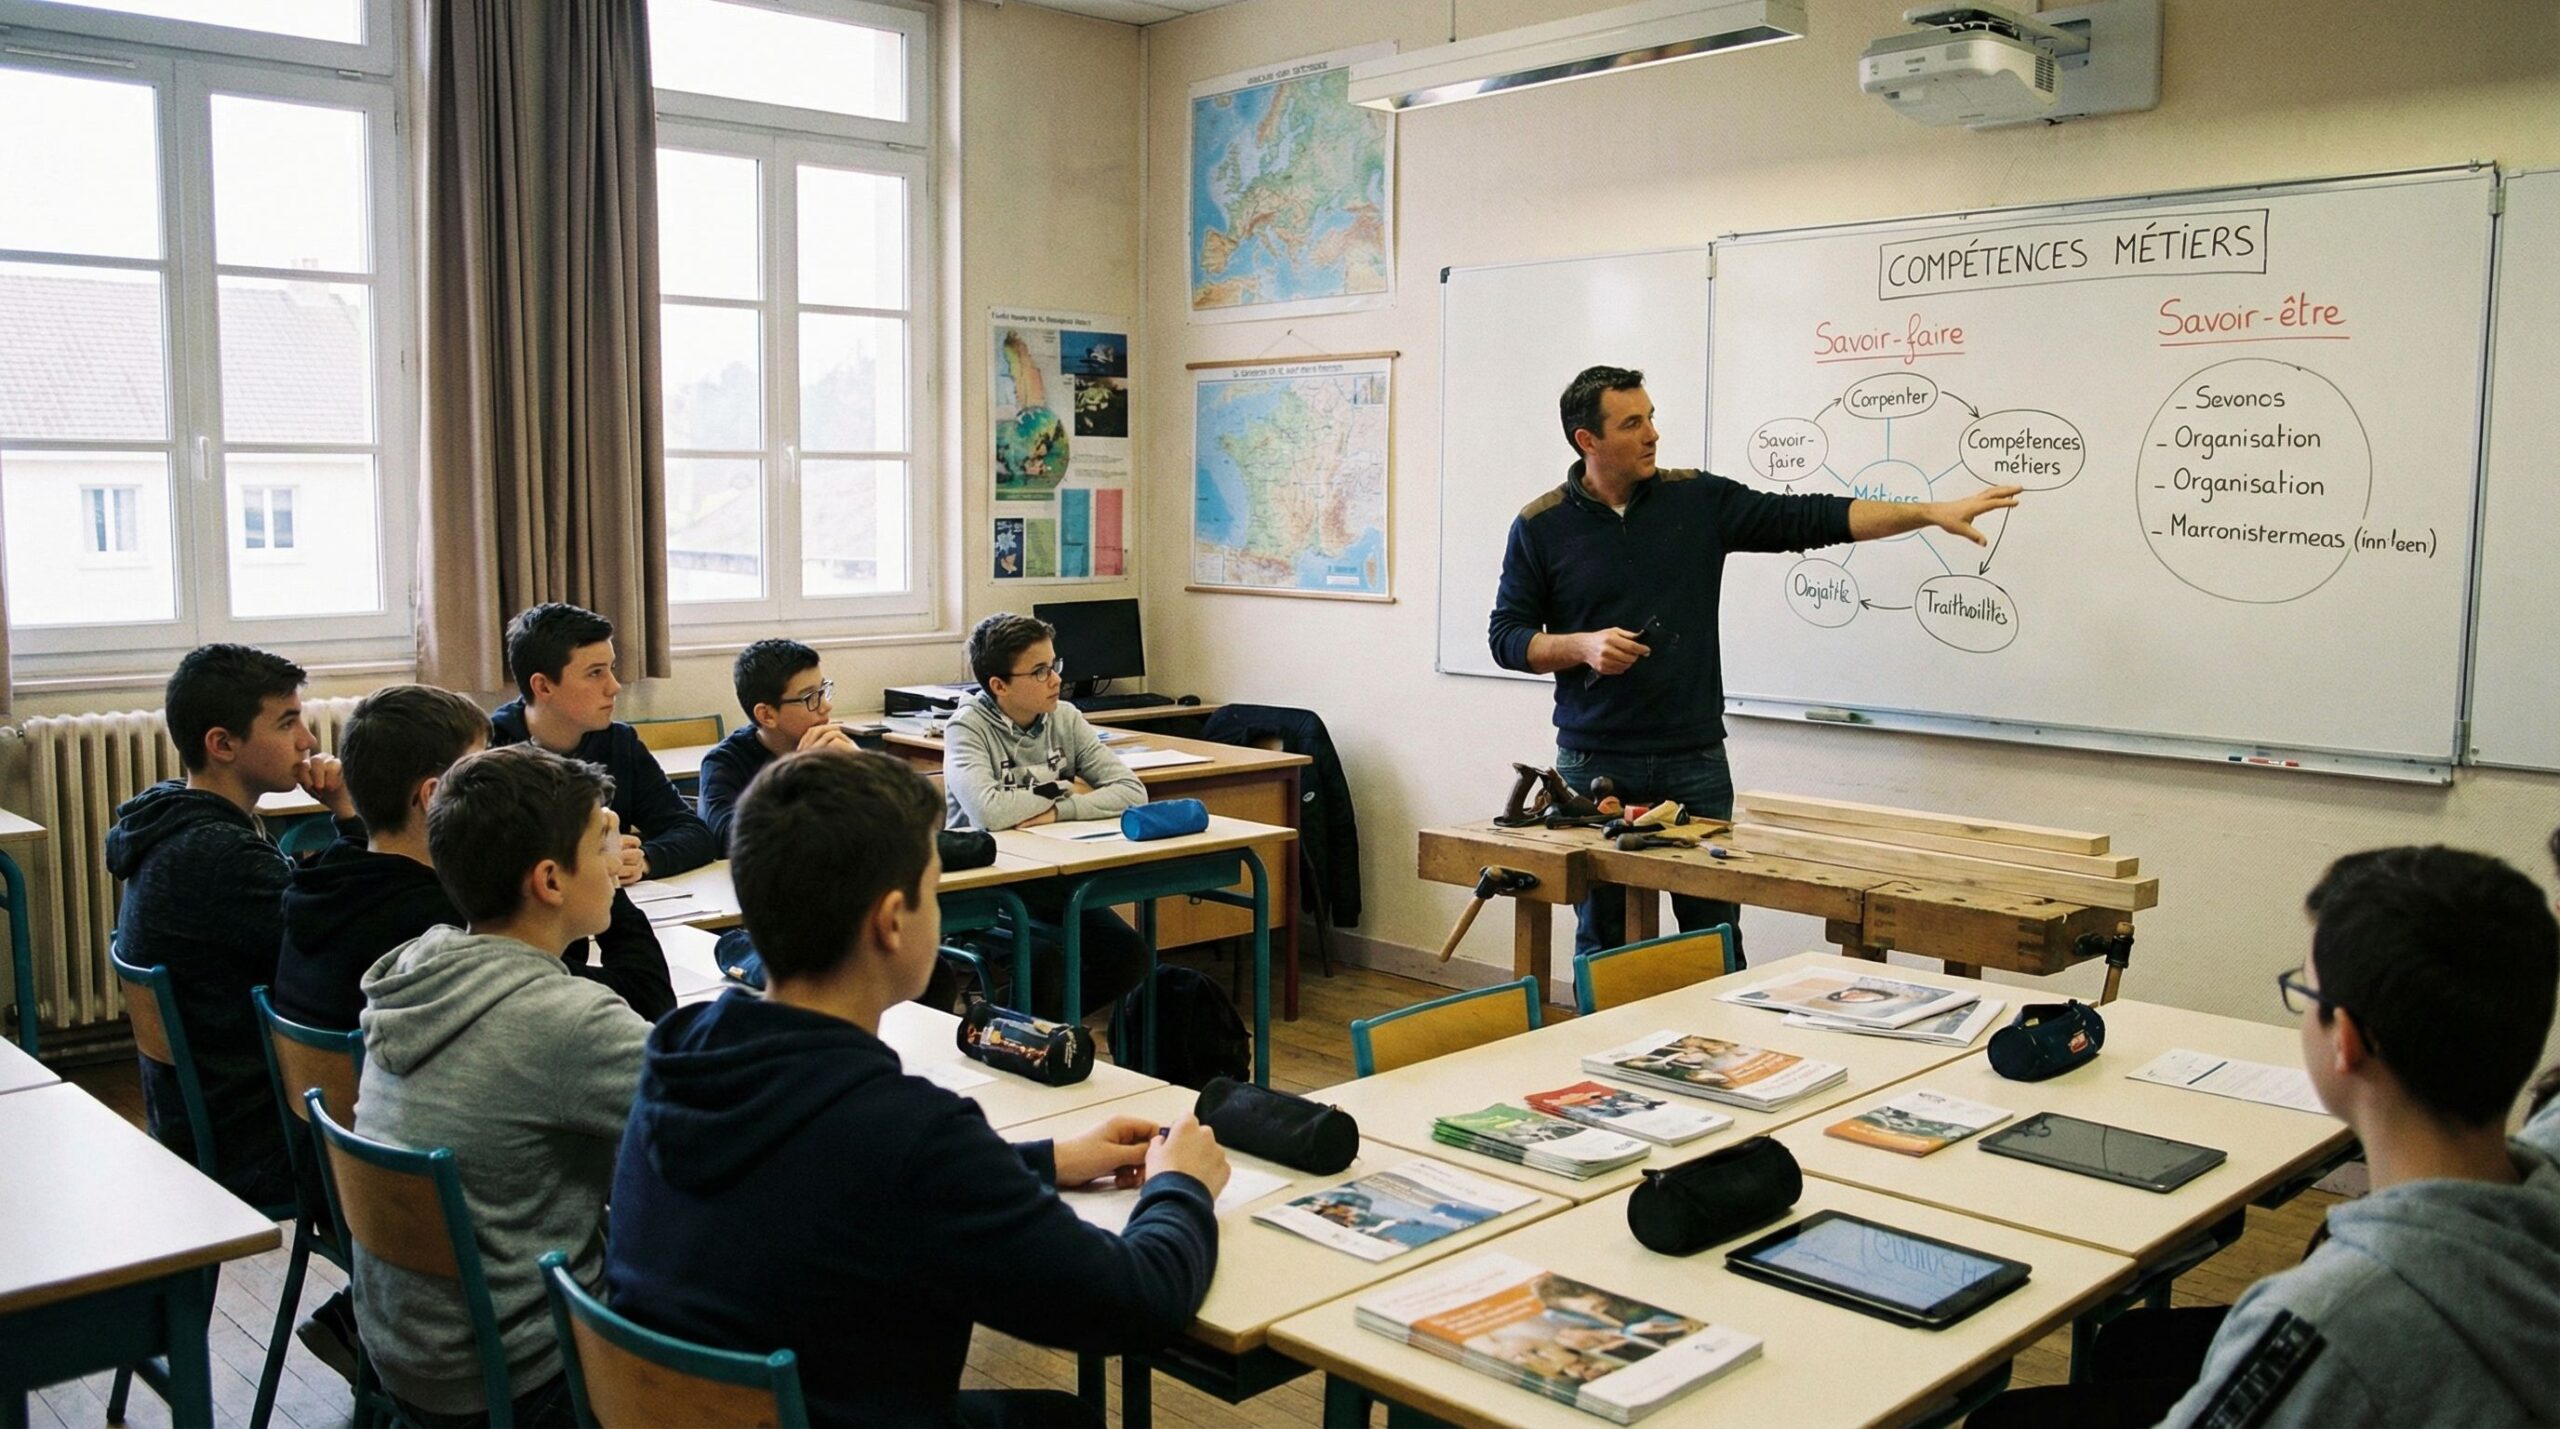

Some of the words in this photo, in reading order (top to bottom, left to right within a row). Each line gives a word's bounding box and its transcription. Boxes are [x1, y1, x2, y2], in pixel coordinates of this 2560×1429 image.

[1887, 238, 2089, 287] COMPÉTENCES
[1814, 312, 1966, 366] Savoir-faire
[1757, 429, 1815, 450] Savoir-
[1967, 427, 2081, 457] Compétences
[2174, 423, 2321, 460] Organisation
[1768, 452, 1806, 477] faire
[1993, 451, 2062, 476] métiers
[2173, 466, 2325, 504] Organisation
